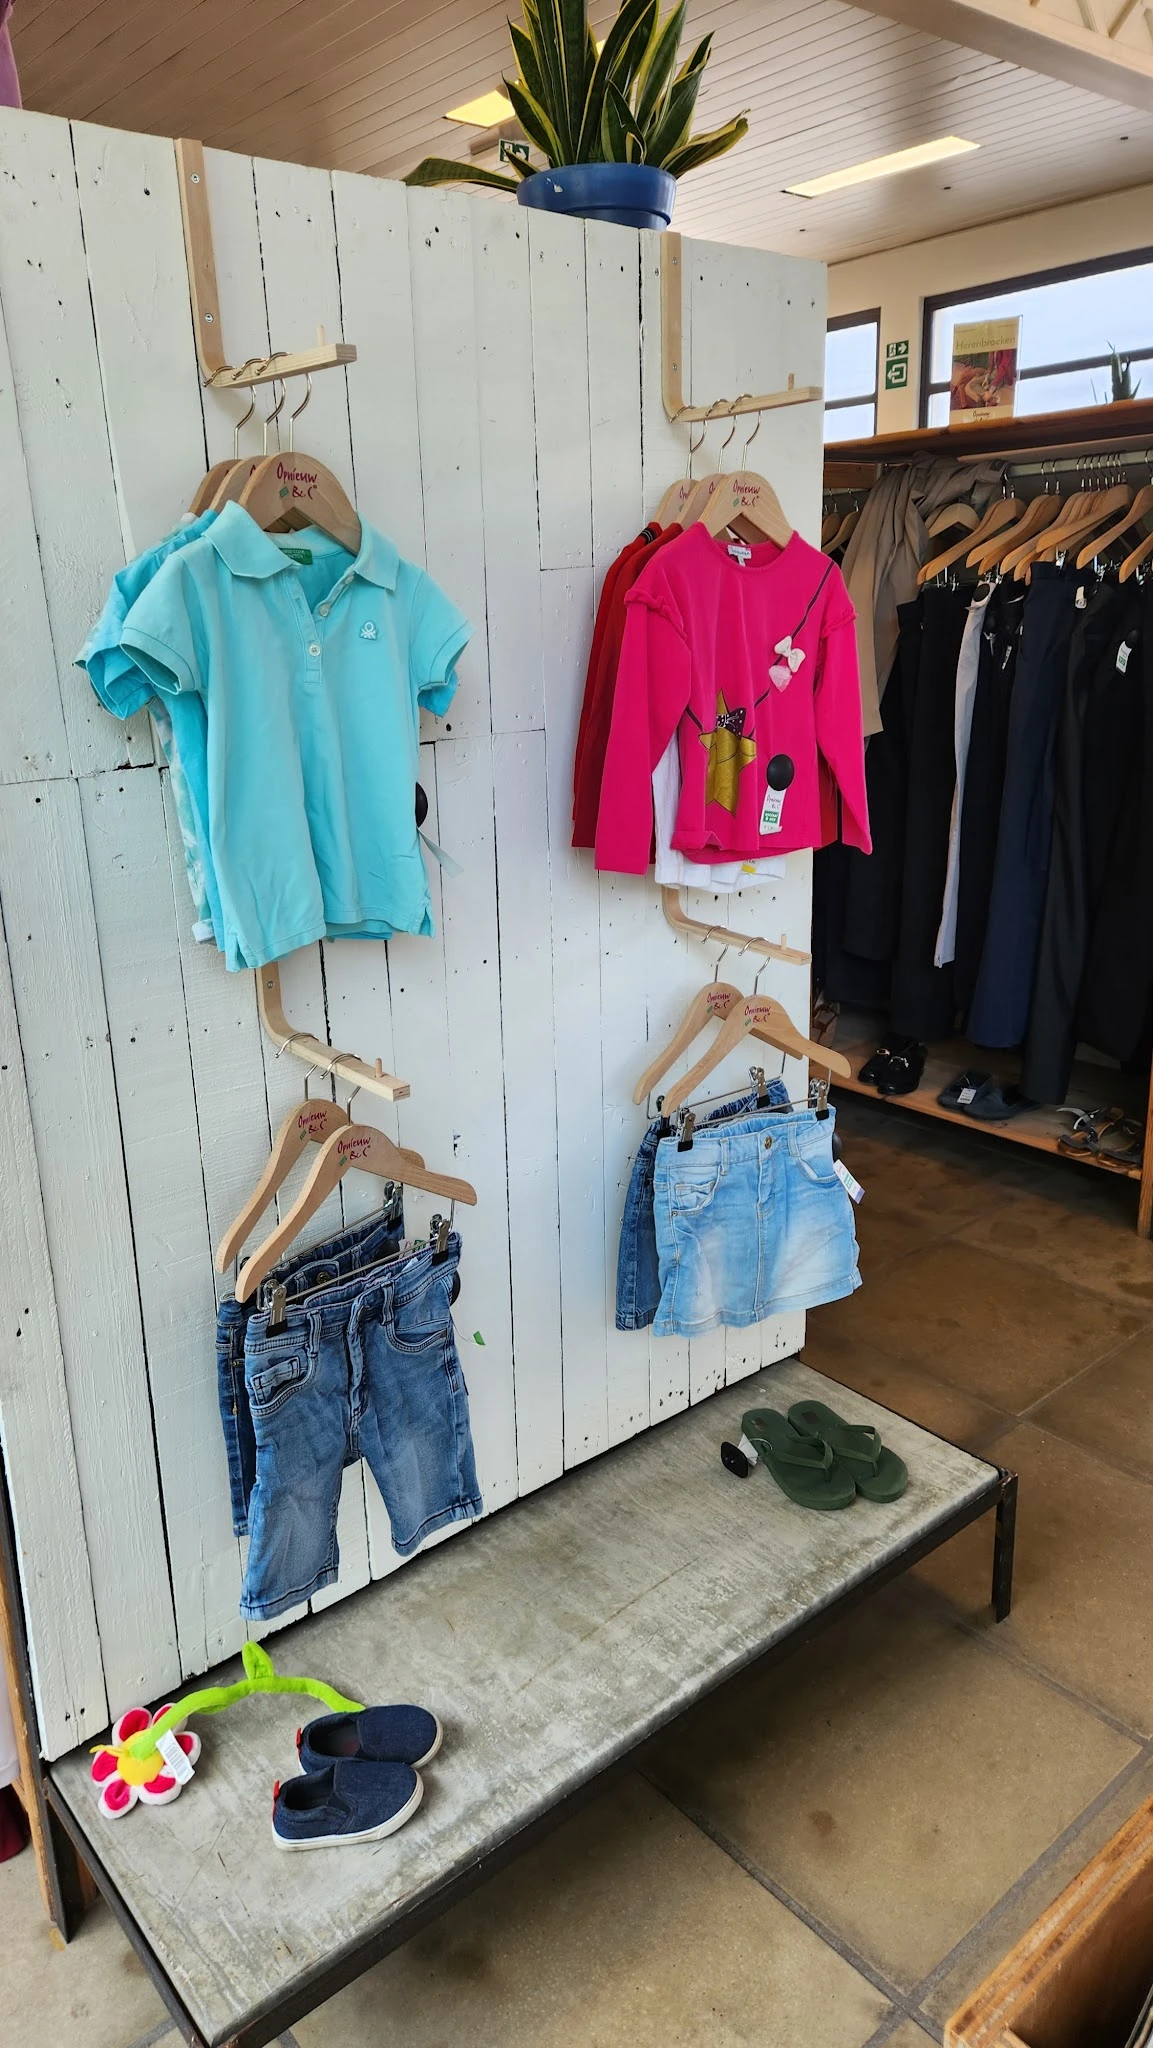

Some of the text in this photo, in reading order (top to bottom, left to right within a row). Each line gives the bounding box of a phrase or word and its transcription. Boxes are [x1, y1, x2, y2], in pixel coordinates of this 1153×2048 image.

[276, 461, 318, 484] Opnieuw
[732, 479, 761, 495] Opnieuw
[706, 992, 732, 1004] Opnieuw
[744, 1005, 772, 1017] Opnieuw
[298, 1110, 328, 1129] Opnieuw
[337, 1136, 372, 1154] Opnieuw
